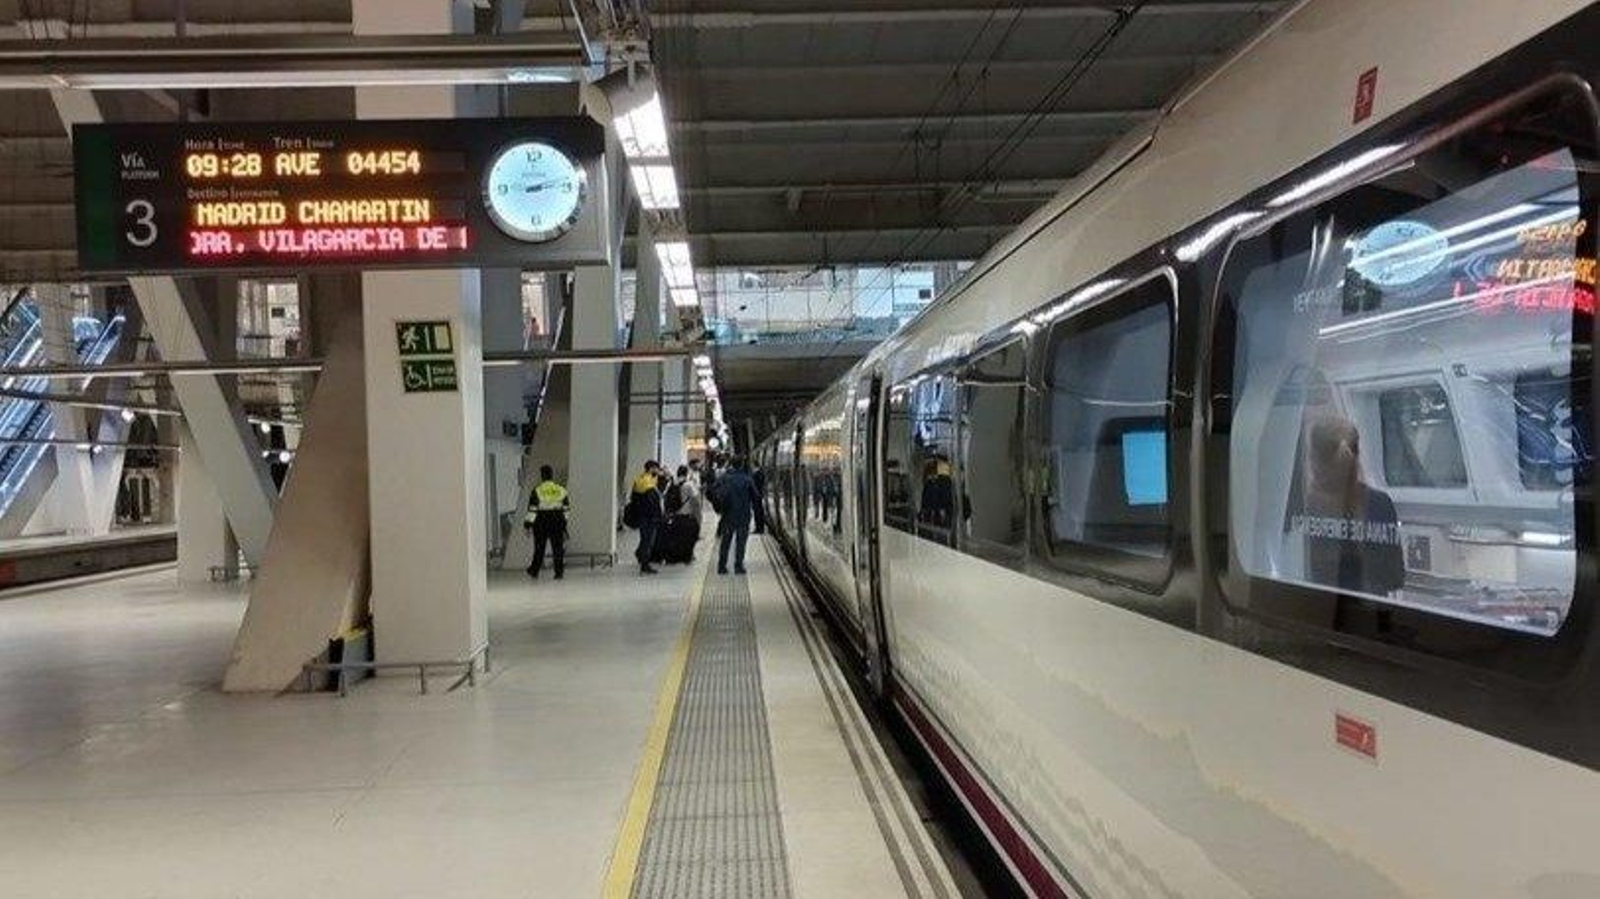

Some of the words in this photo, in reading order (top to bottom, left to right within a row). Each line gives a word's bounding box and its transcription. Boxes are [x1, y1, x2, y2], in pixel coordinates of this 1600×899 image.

[186, 153, 262, 178] 09:28
[275, 152, 321, 176] AVE
[347, 150, 421, 175] 04454
[126, 199, 158, 247] 3
[198, 202, 286, 226] MADRID
[299, 199, 430, 224] CHAMARTIN
[259, 228, 404, 252] VILAGARCIA
[417, 227, 448, 249] DE
